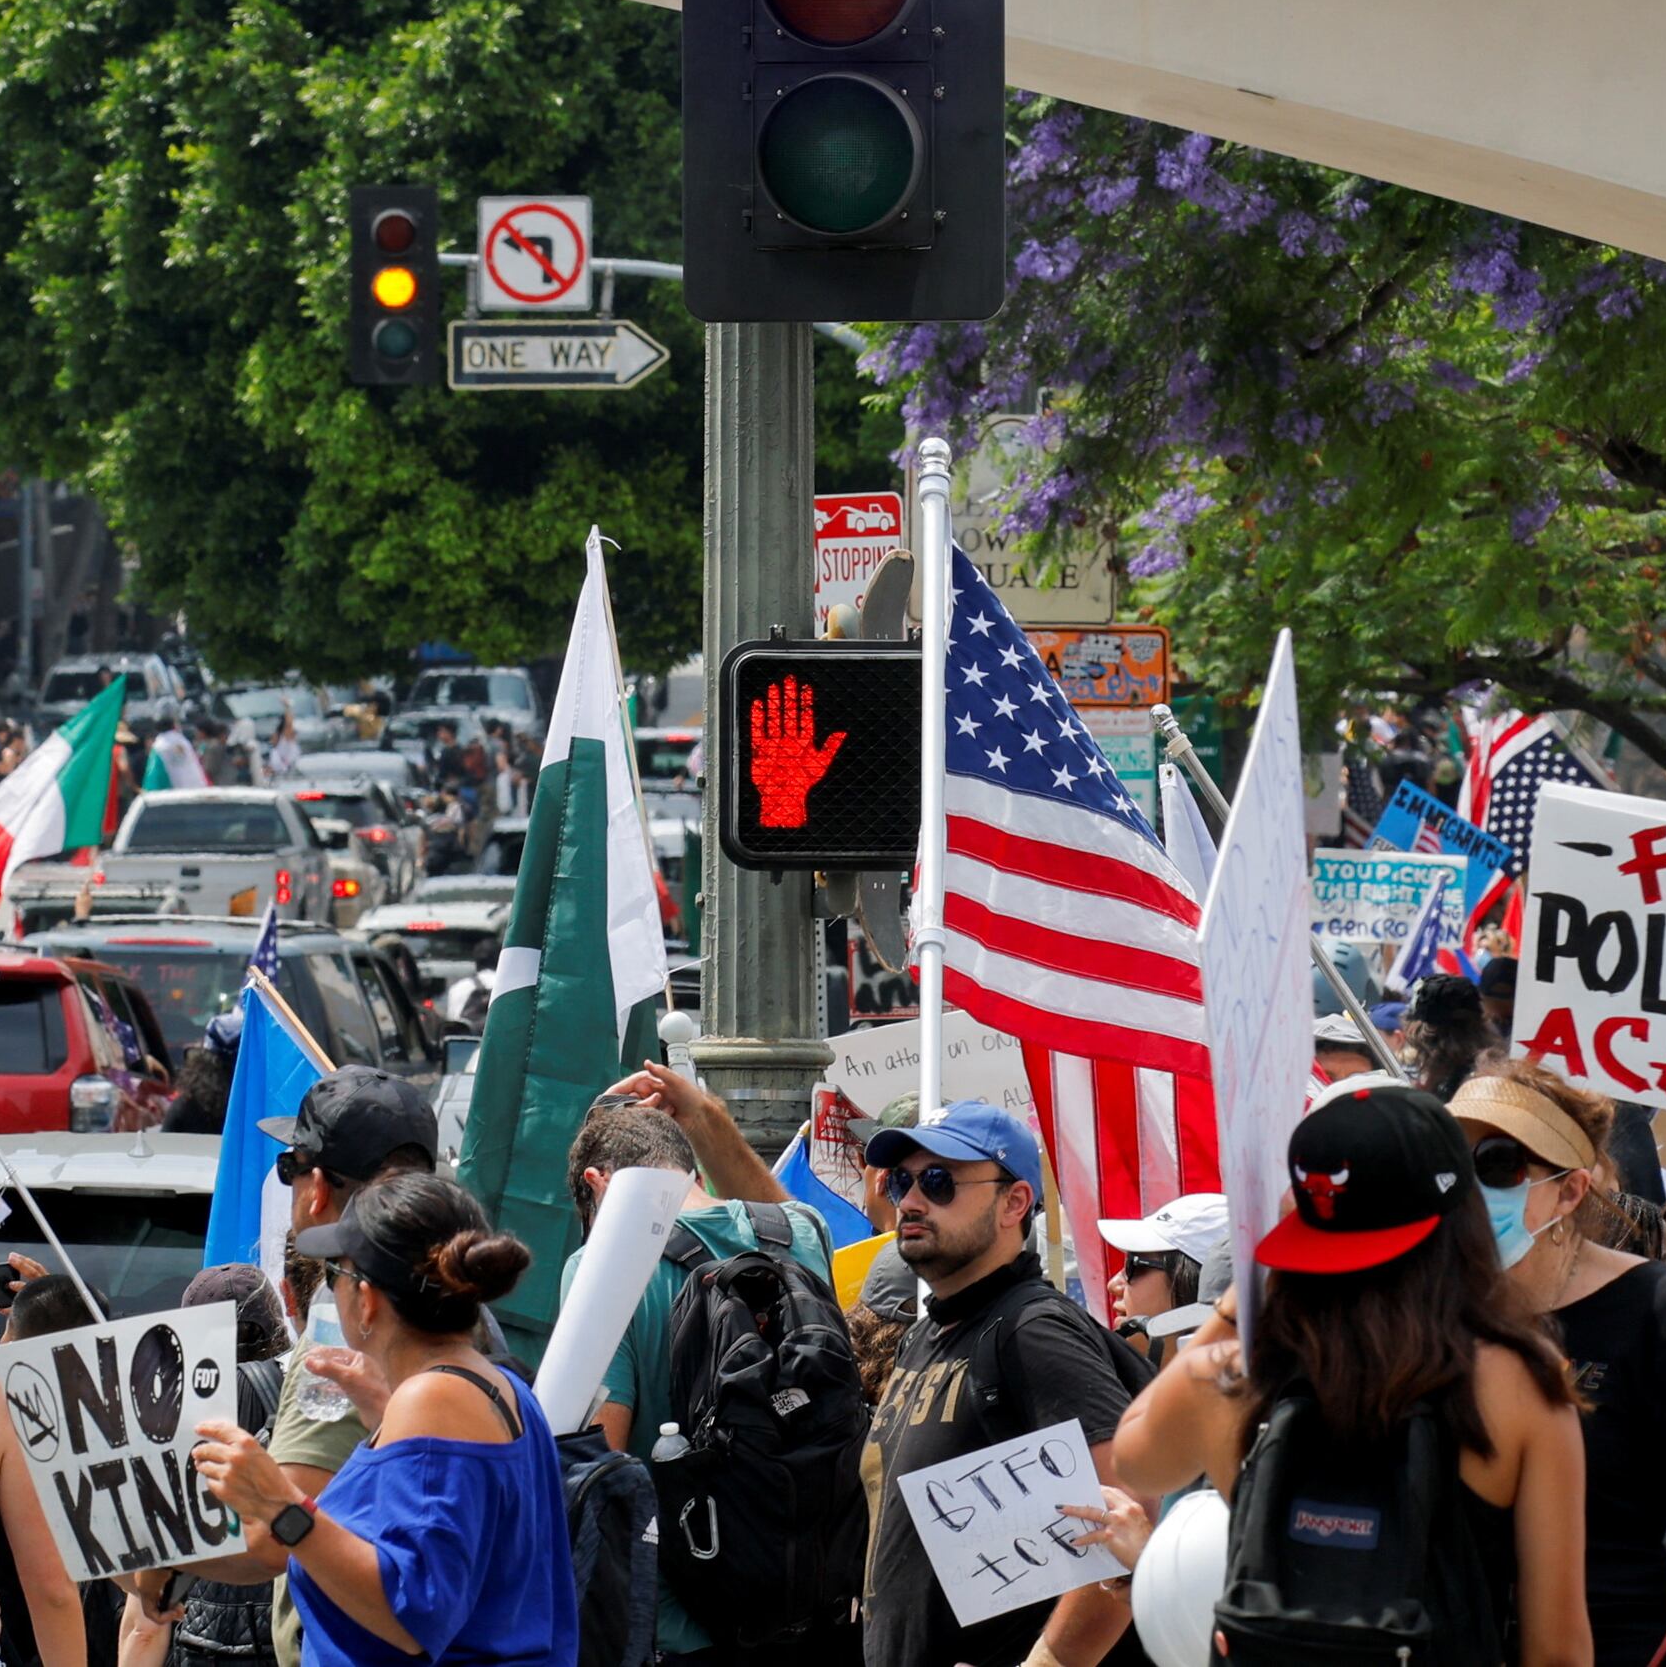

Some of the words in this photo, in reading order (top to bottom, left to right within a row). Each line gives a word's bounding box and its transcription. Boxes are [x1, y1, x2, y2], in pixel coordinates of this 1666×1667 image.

[467, 340, 527, 369] ONE
[549, 340, 612, 369] WAY
[845, 1054, 878, 1077] An
[884, 1047, 921, 1073] atta
[50, 1323, 185, 1456] NO
[193, 1367, 219, 1390] FDT
[925, 1438, 1077, 1533] GTFO
